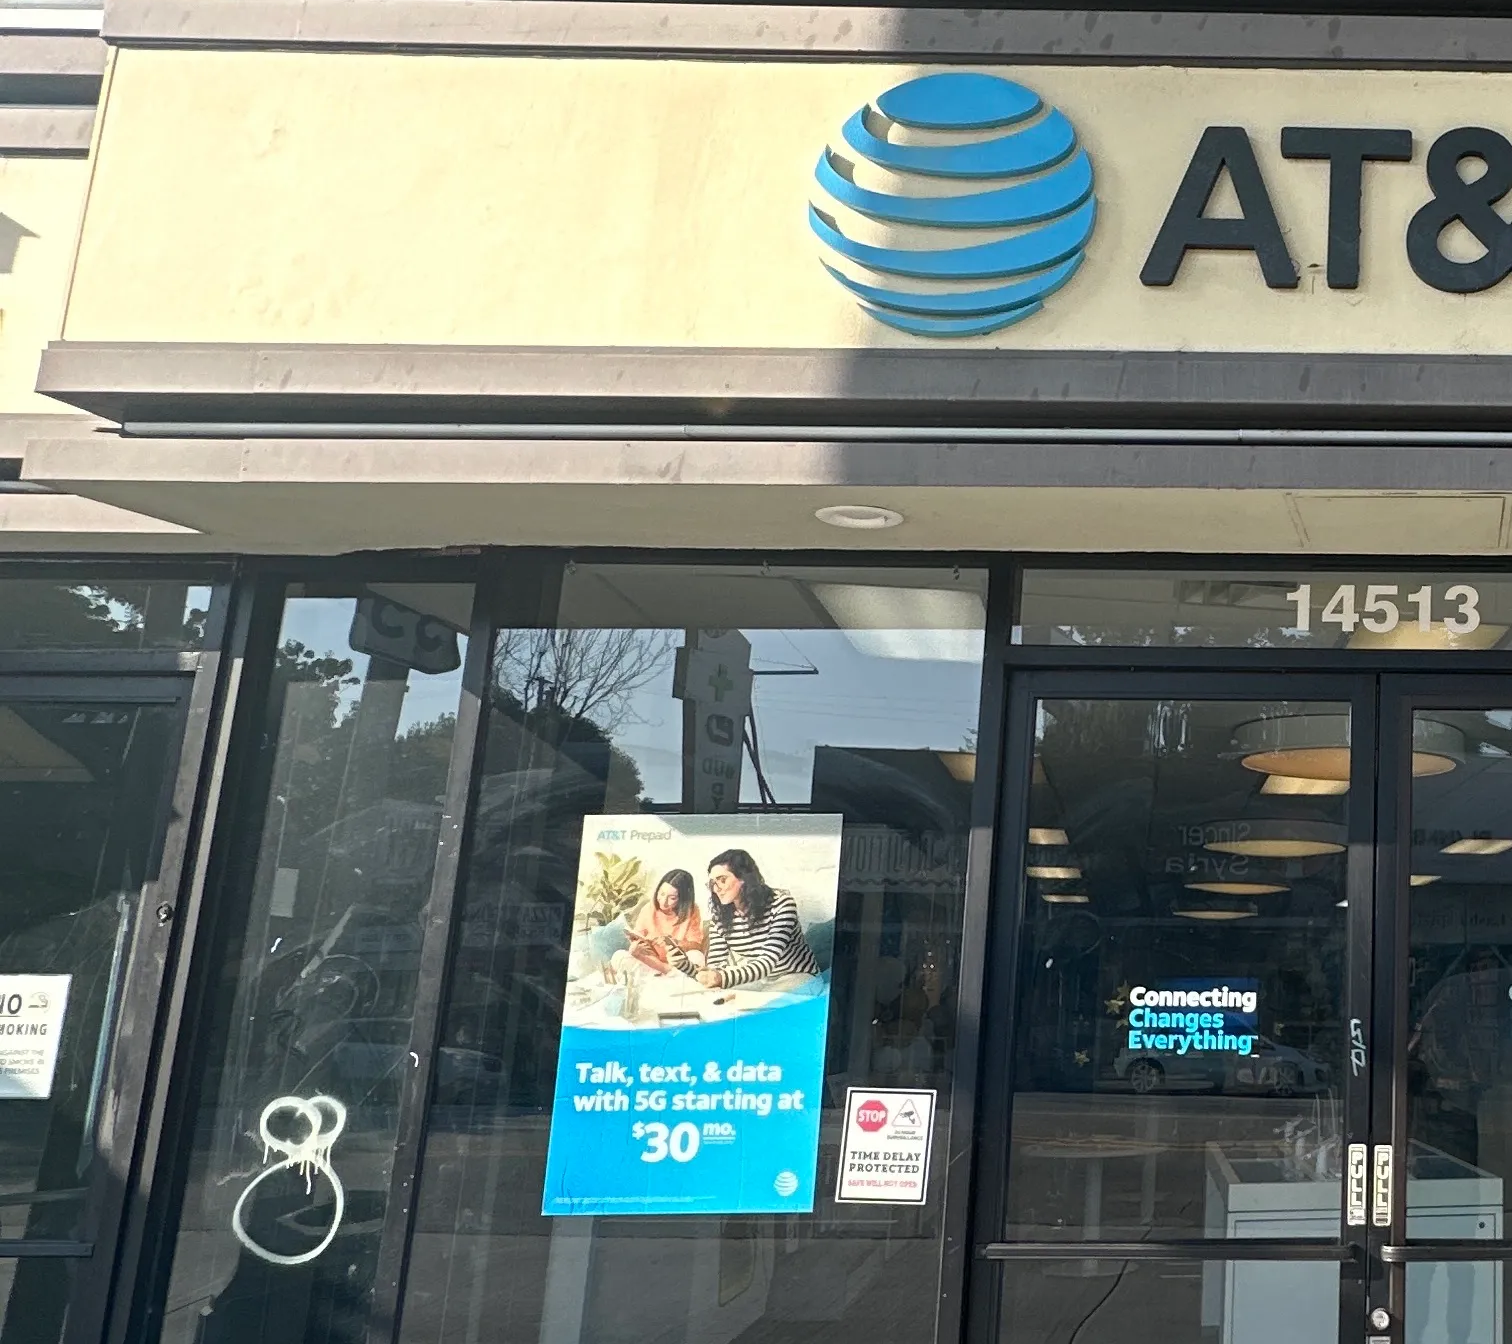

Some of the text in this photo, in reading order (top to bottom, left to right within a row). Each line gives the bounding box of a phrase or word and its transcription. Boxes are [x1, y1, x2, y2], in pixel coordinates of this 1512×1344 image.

[1285, 583, 1482, 634] 14513
[597, 829, 627, 841] AT&T
[1129, 986, 1257, 1013] Connecting
[1128, 1008, 1225, 1033] Changes
[1128, 1030, 1252, 1056] Everything
[575, 1060, 782, 1087] Talk, text, & data
[573, 1087, 805, 1116] with 5G starting at
[703, 1121, 737, 1136] mo.
[858, 1109, 887, 1123] STOP
[848, 1163, 920, 1173] PROTECTED
[850, 1151, 921, 1161] TIME DELAY
[1350, 1151, 1363, 1206] PULL
[1376, 1152, 1389, 1207] PULL
